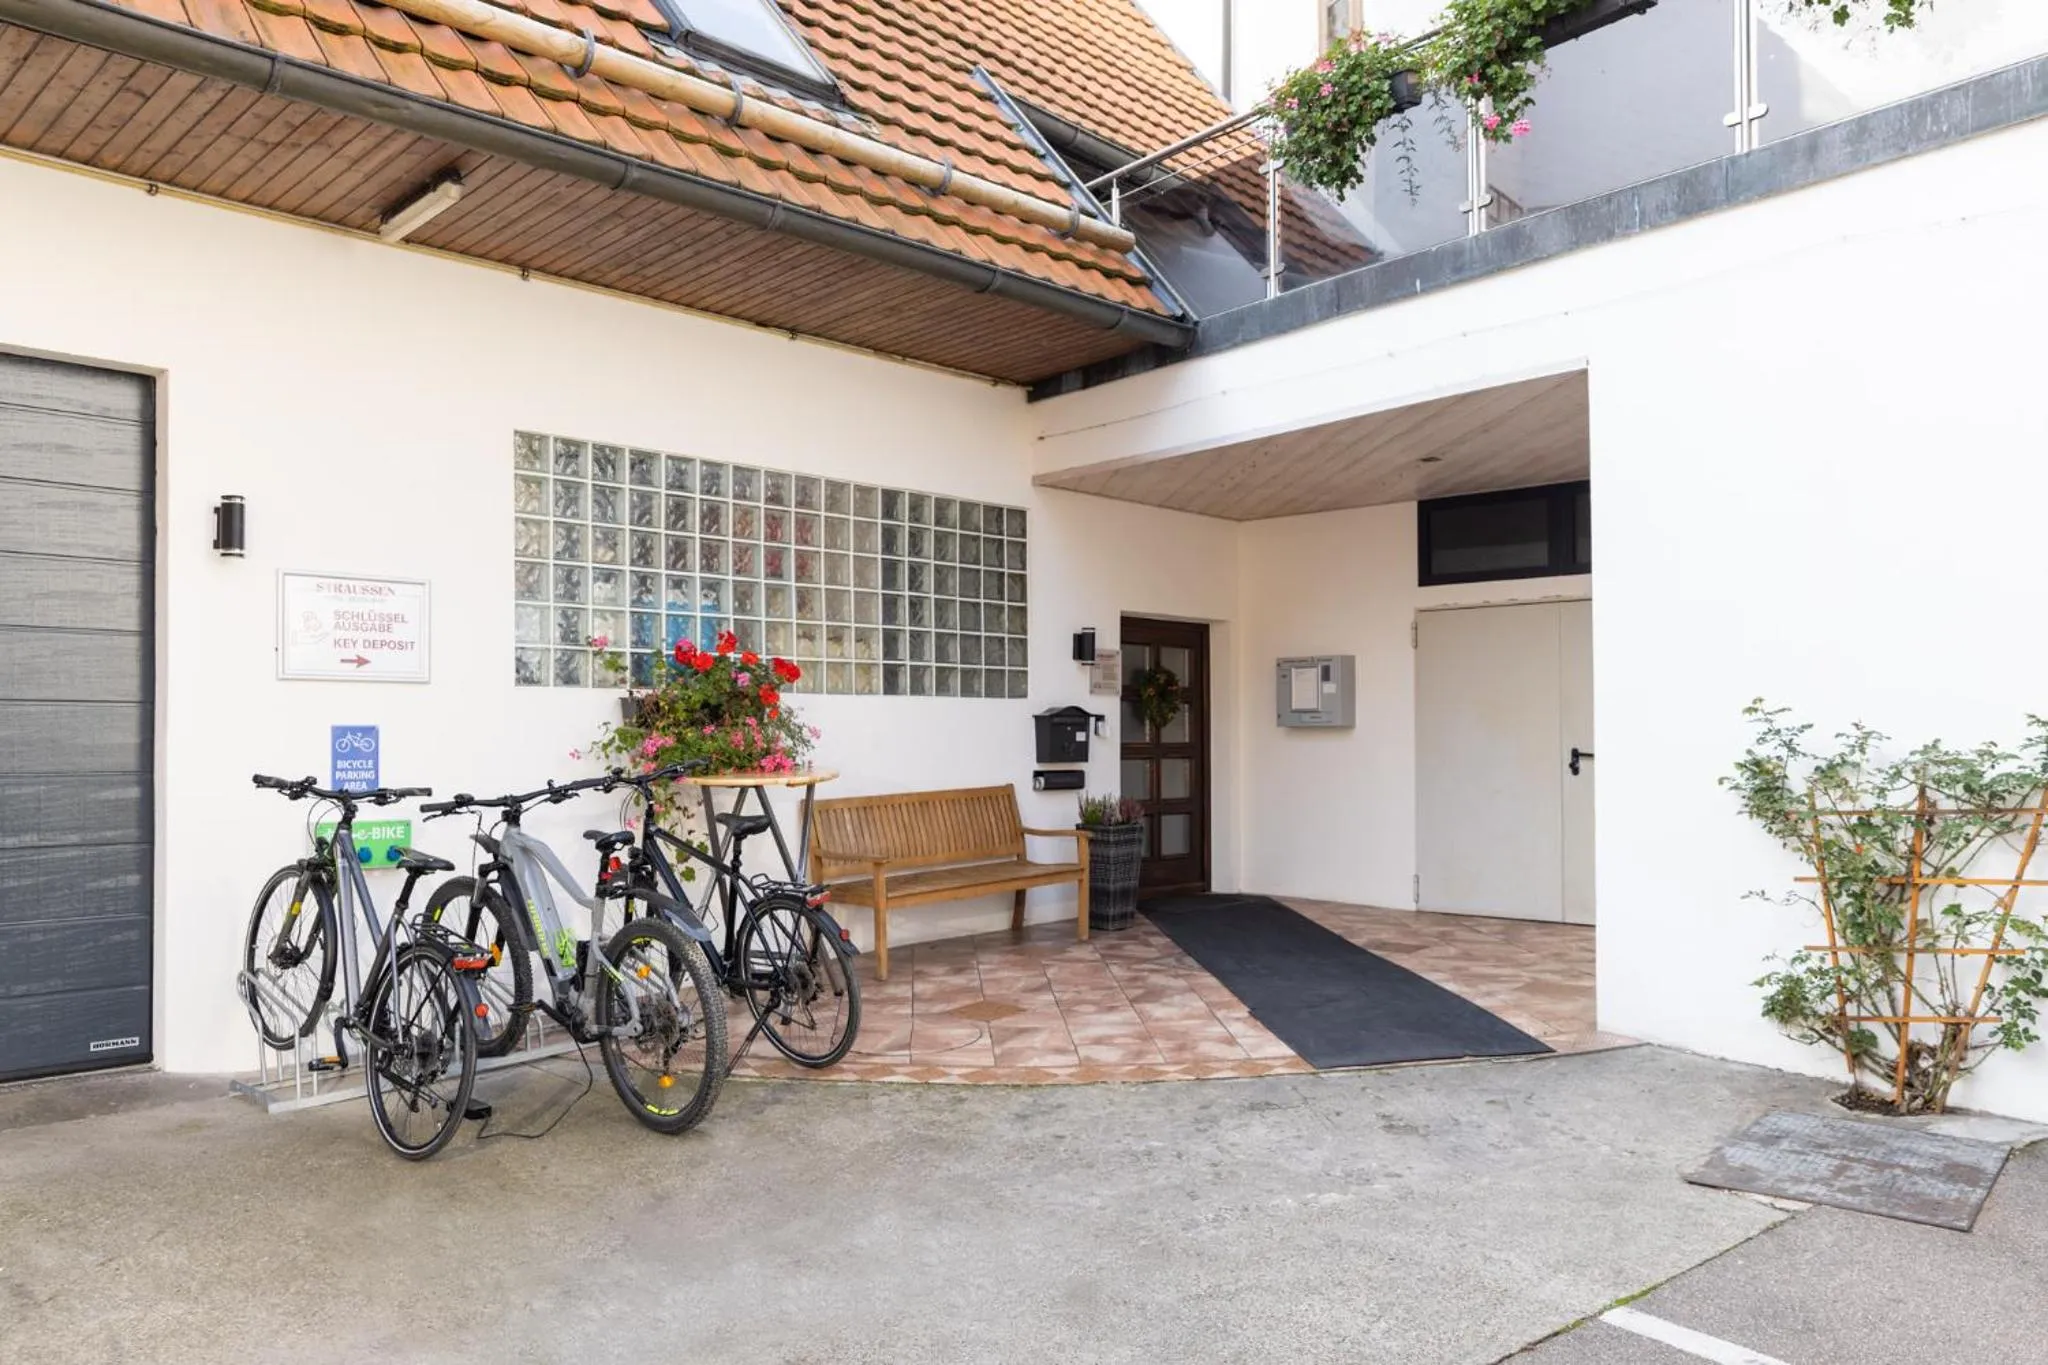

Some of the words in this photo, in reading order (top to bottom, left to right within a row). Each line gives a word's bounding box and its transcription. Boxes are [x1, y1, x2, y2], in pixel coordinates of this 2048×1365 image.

[316, 583, 396, 596] STRAUSSEN
[333, 609, 408, 623] SCHLÜSSEL
[333, 622, 393, 633] AUSGABE
[333, 638, 358, 649] KEY
[362, 639, 415, 650] DEPOSIT
[337, 760, 373, 769] BICYCLE
[336, 771, 375, 780] PARKING
[343, 782, 367, 790] AREA
